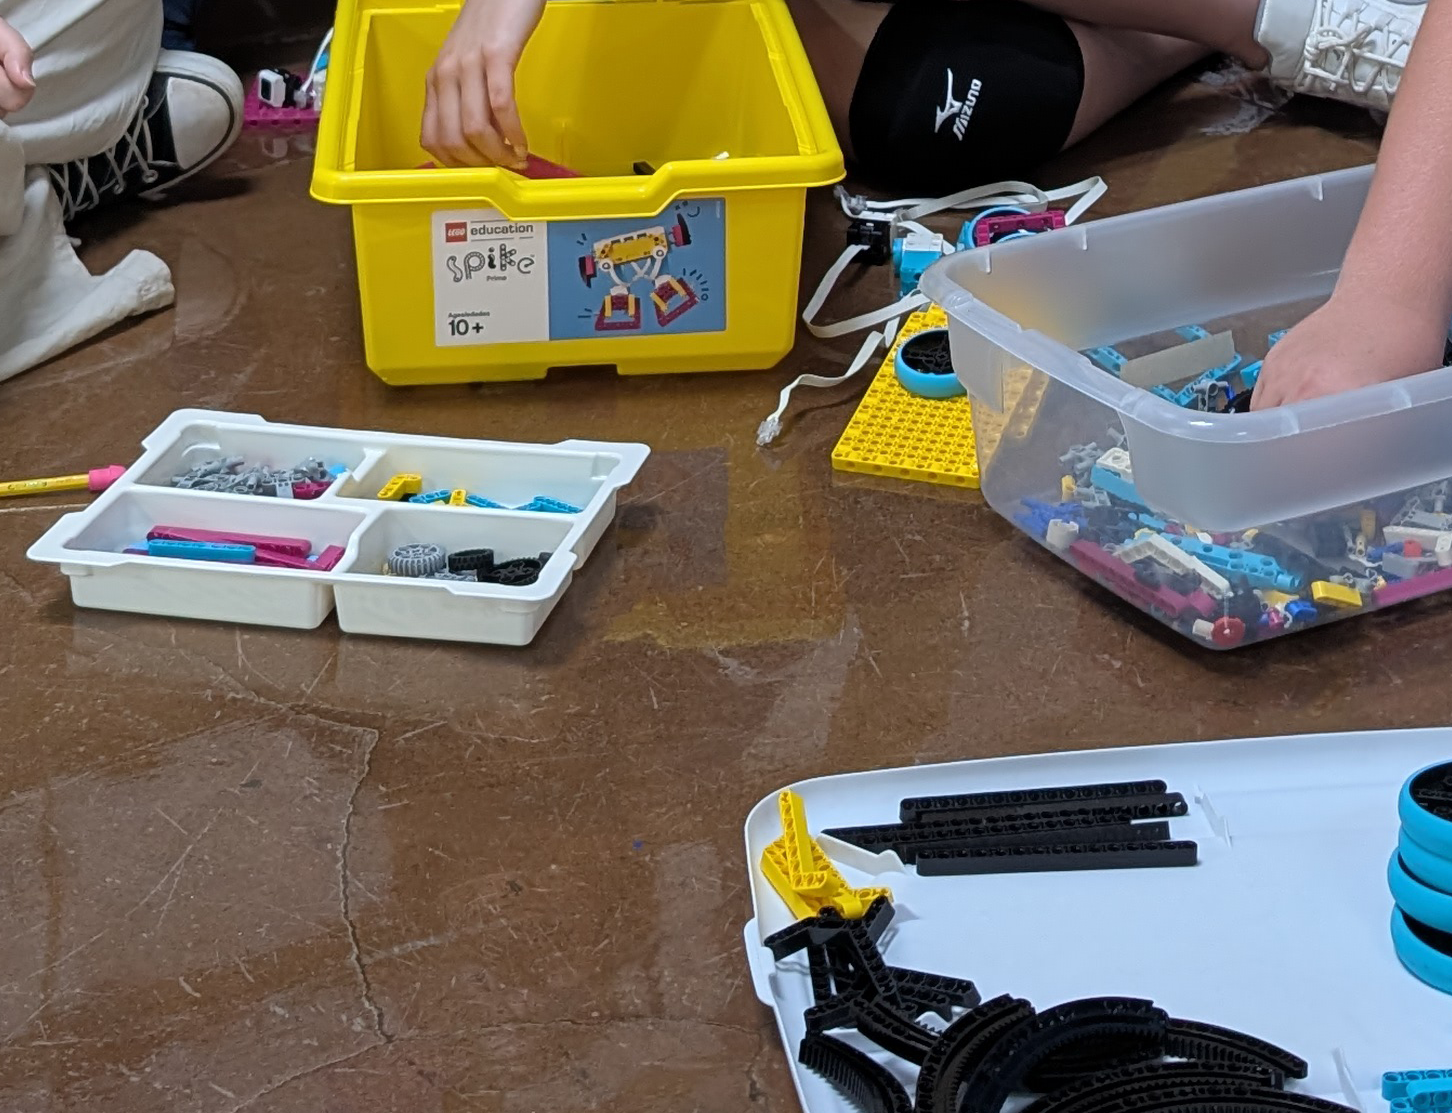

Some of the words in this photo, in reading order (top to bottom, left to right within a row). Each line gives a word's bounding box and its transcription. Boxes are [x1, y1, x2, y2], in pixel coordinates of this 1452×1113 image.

[953, 78, 982, 141] MIZUNO
[447, 227, 466, 237] LEGO
[470, 223, 534, 236] education
